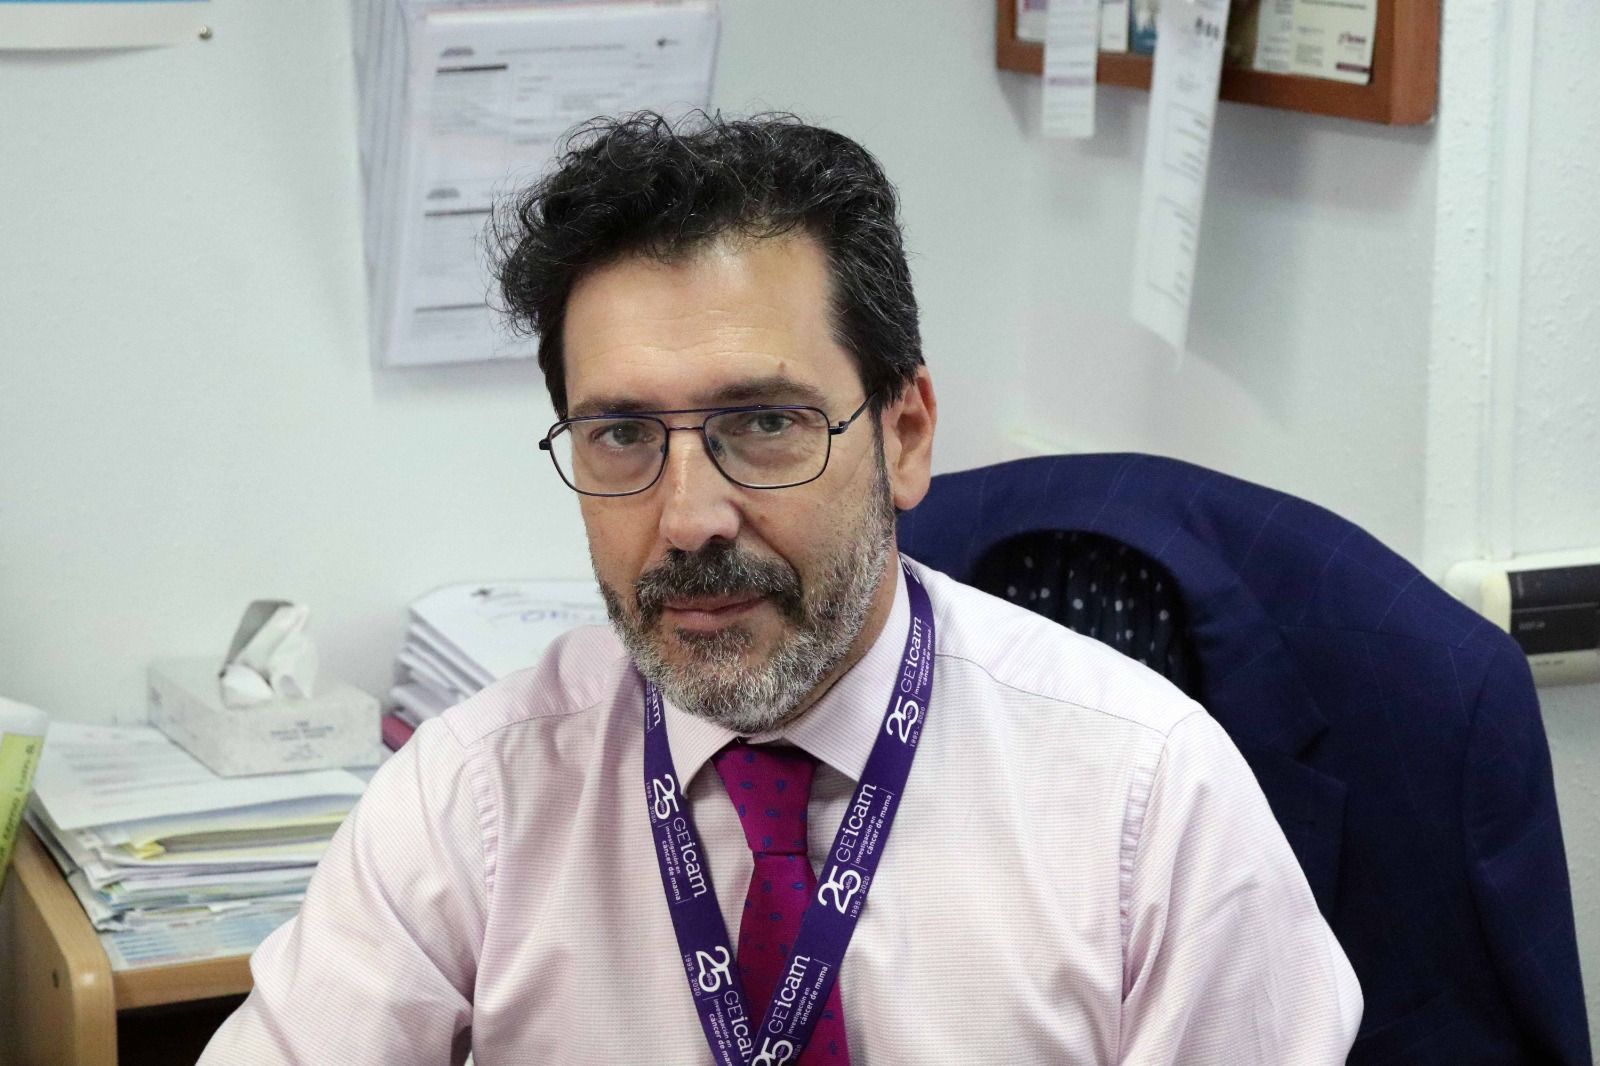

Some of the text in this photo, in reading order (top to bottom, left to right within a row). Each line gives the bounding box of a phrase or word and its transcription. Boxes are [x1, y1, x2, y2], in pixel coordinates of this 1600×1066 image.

[901, 616, 922, 693] GEicam
[886, 695, 919, 744] 25
[652, 773, 680, 820] 25
[835, 783, 877, 863] GEicam
[875, 818, 884, 829] de
[880, 794, 892, 818] mama
[673, 817, 707, 898] GEicam
[817, 865, 862, 914] 25
[695, 945, 733, 993] 25
[768, 955, 811, 1034] GEicam
[800, 966, 829, 1025] cáncer de mama
